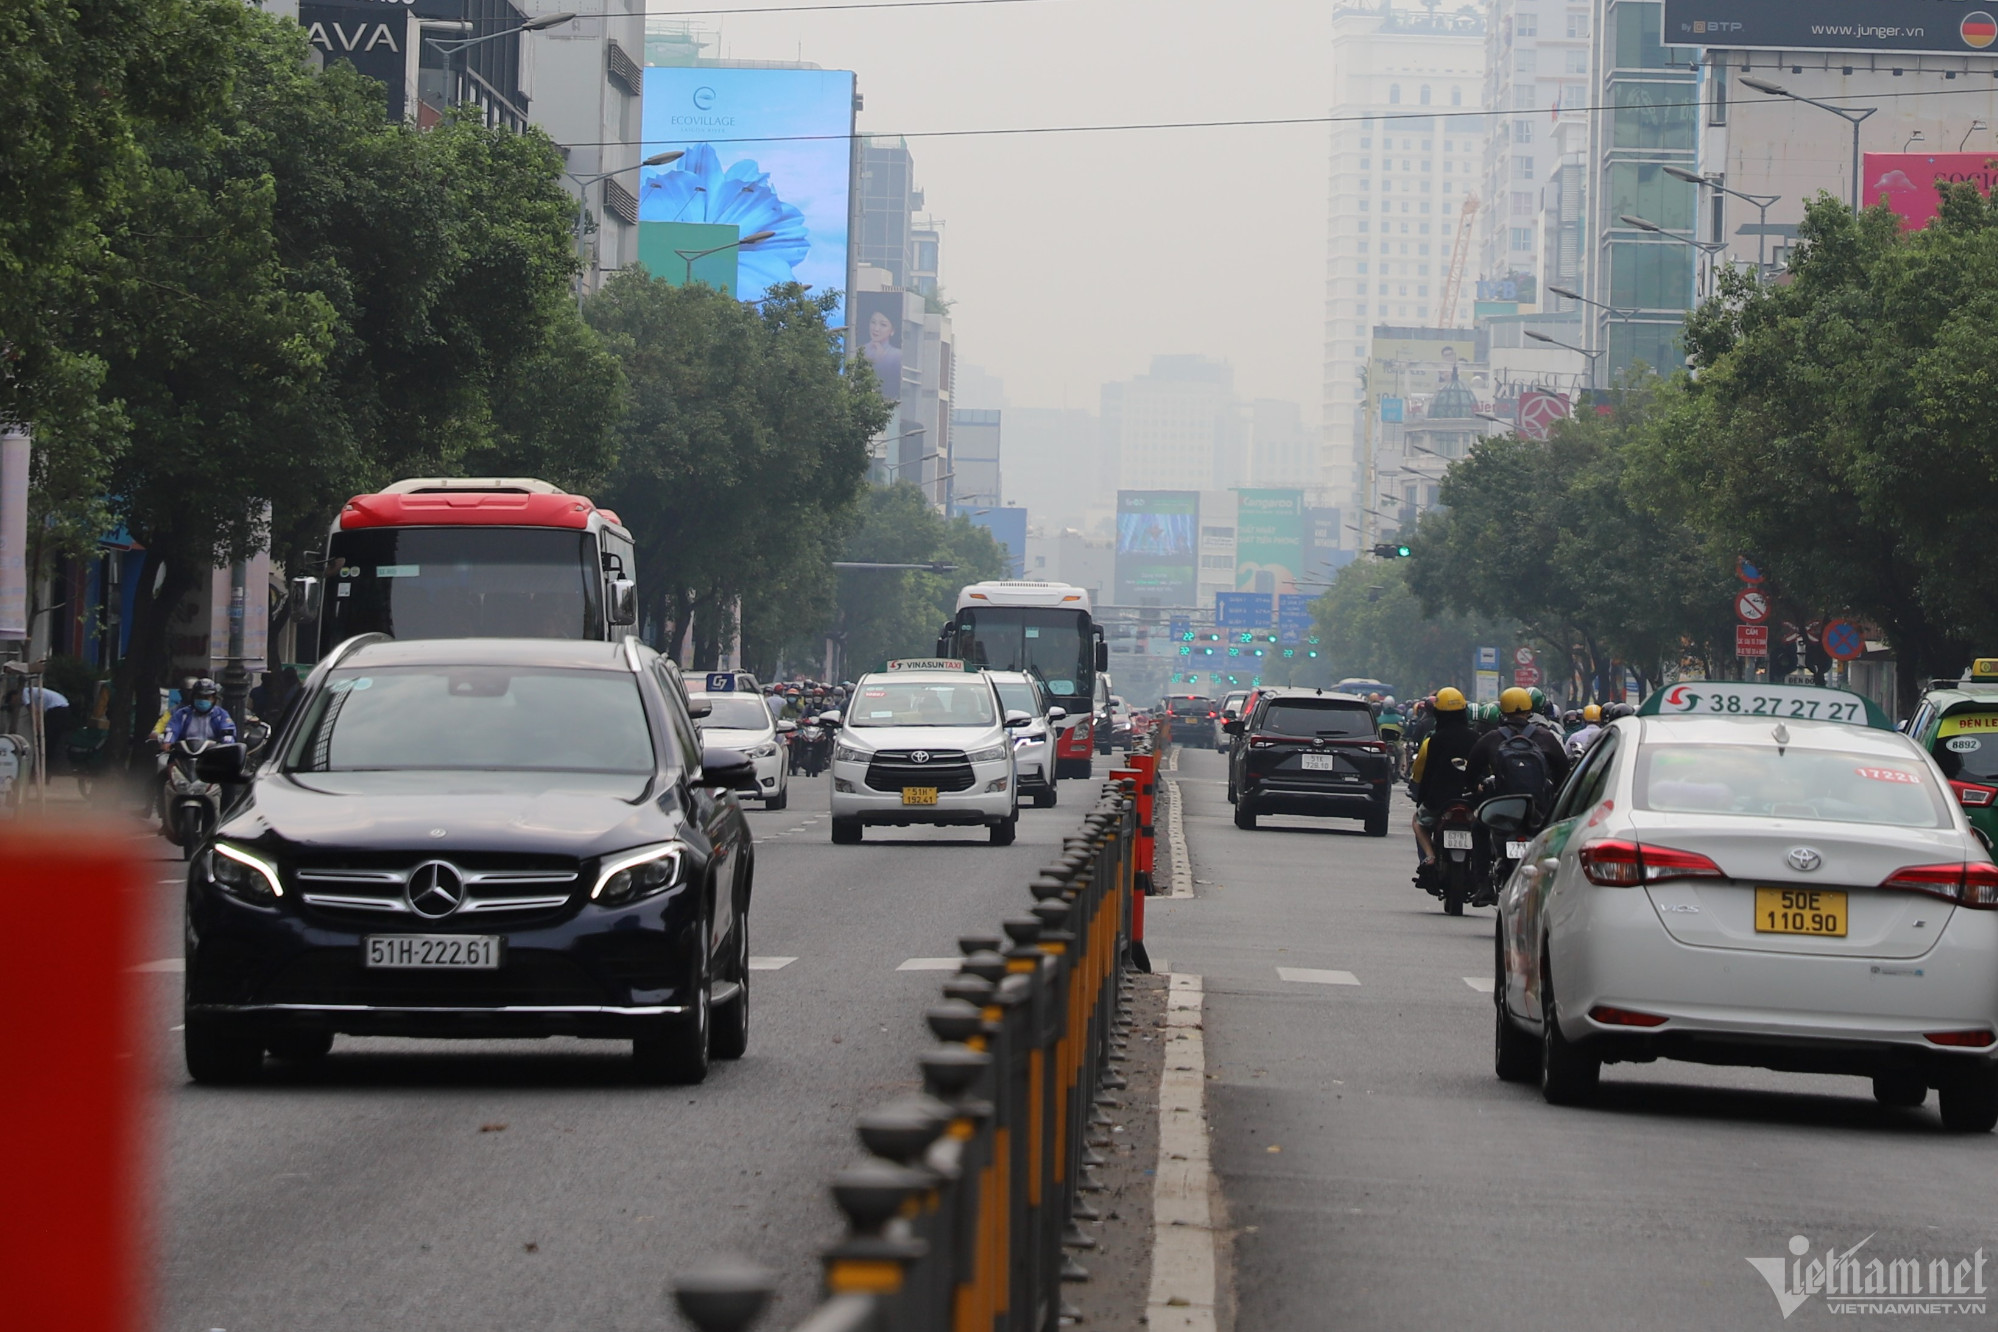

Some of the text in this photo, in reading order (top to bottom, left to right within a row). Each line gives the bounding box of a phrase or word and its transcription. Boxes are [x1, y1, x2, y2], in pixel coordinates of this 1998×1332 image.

[308, 22, 399, 52] AVA
[1811, 23, 1924, 39] www.junger.vn
[671, 115, 735, 126] ECOVILLAGE
[1710, 694, 1859, 720] 38.27 27 27
[1959, 718, 1982, 728] ĐÈN
[1952, 740, 1977, 749] 8892
[1660, 903, 1700, 913] VIOS
[1781, 891, 1821, 911] 50E
[1767, 911, 1837, 933] 110.90
[371, 939, 491, 965] 51H-222.61
